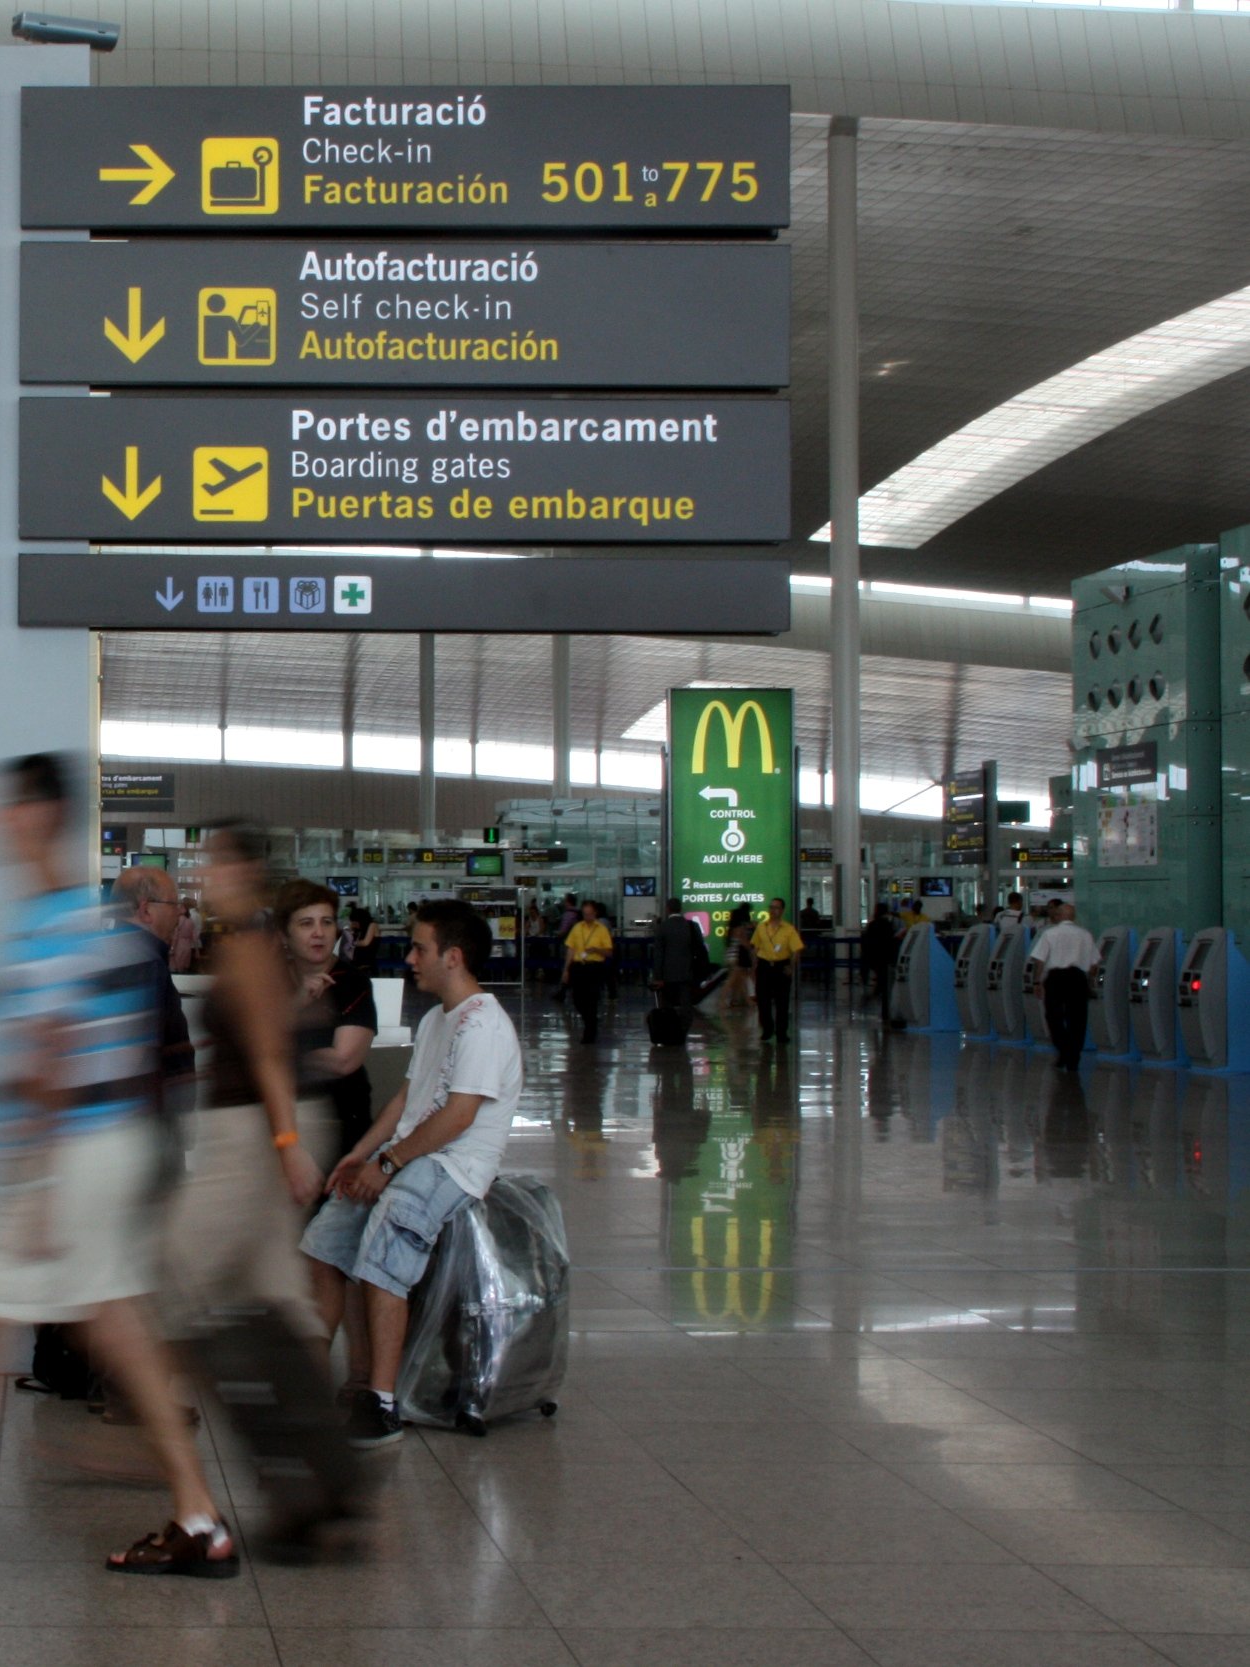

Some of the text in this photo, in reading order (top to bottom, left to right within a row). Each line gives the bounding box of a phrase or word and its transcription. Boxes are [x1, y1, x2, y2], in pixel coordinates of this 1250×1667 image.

[304, 95, 485, 125] Facturació
[302, 138, 431, 163] Check-in
[304, 162, 759, 207] Facturación 501 to a 775
[300, 251, 538, 282] Autofacturació
[300, 293, 512, 320] Self check-in
[300, 330, 558, 361] Autofacturación
[291, 409, 718, 442] Portes d'embarcament
[291, 452, 512, 484] Boarding gates
[291, 488, 695, 525] Puertas de embarque
[710, 809, 756, 819] CONTROL
[703, 854, 728, 863] AQUÍ
[736, 854, 763, 863] HERE
[682, 877, 744, 889] 2 Restaurants:
[682, 893, 723, 902] PORTES
[732, 893, 765, 902] GATES
